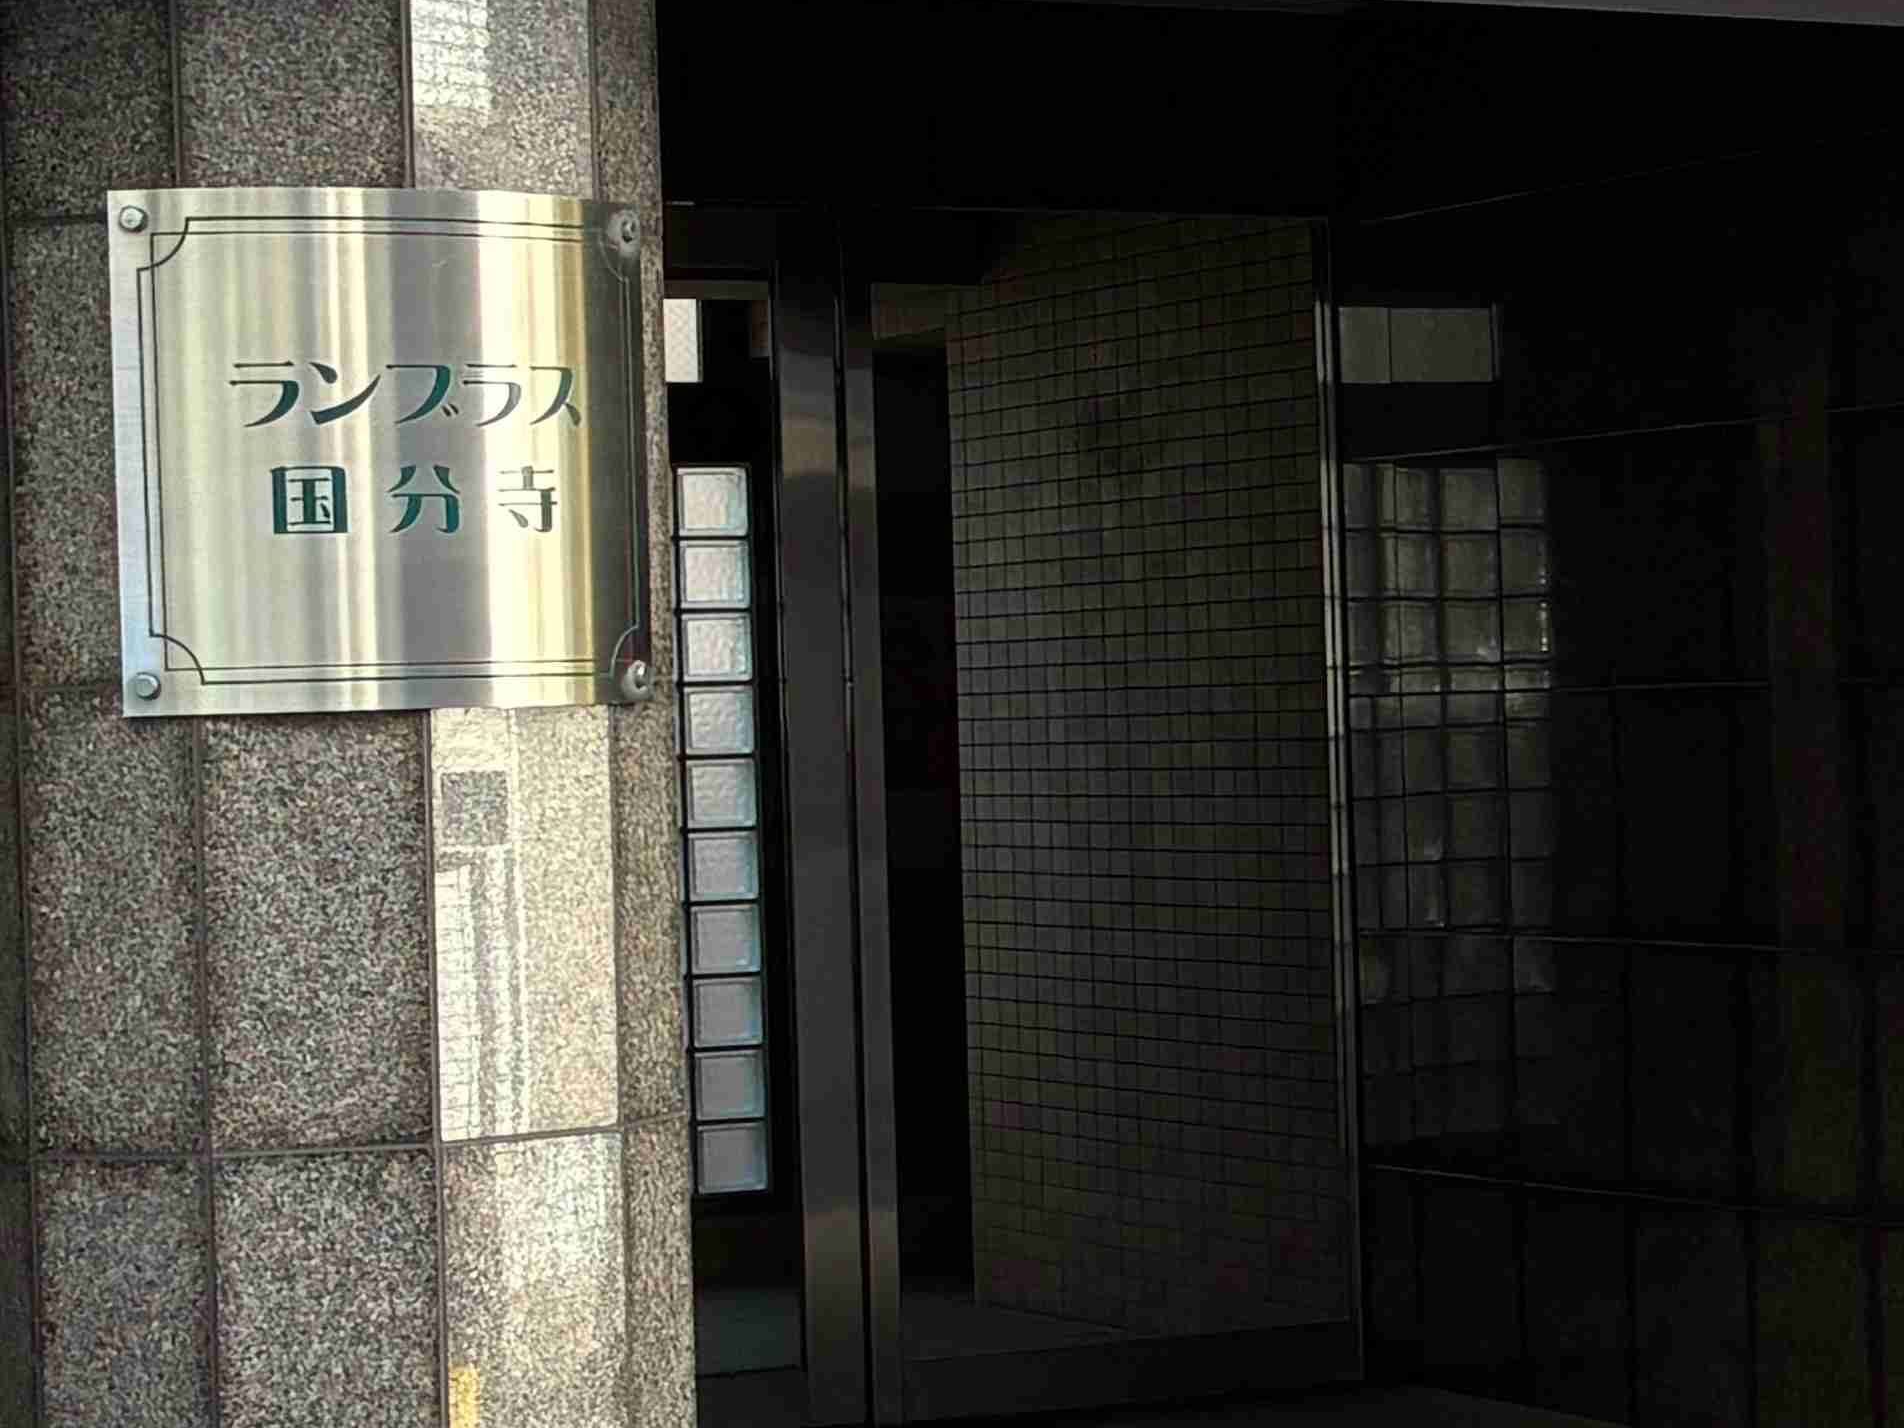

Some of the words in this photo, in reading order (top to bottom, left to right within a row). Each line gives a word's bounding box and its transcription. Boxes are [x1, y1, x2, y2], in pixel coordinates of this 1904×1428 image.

[229, 360, 582, 428] ランブラス
[269, 465, 559, 535] 国分寺
